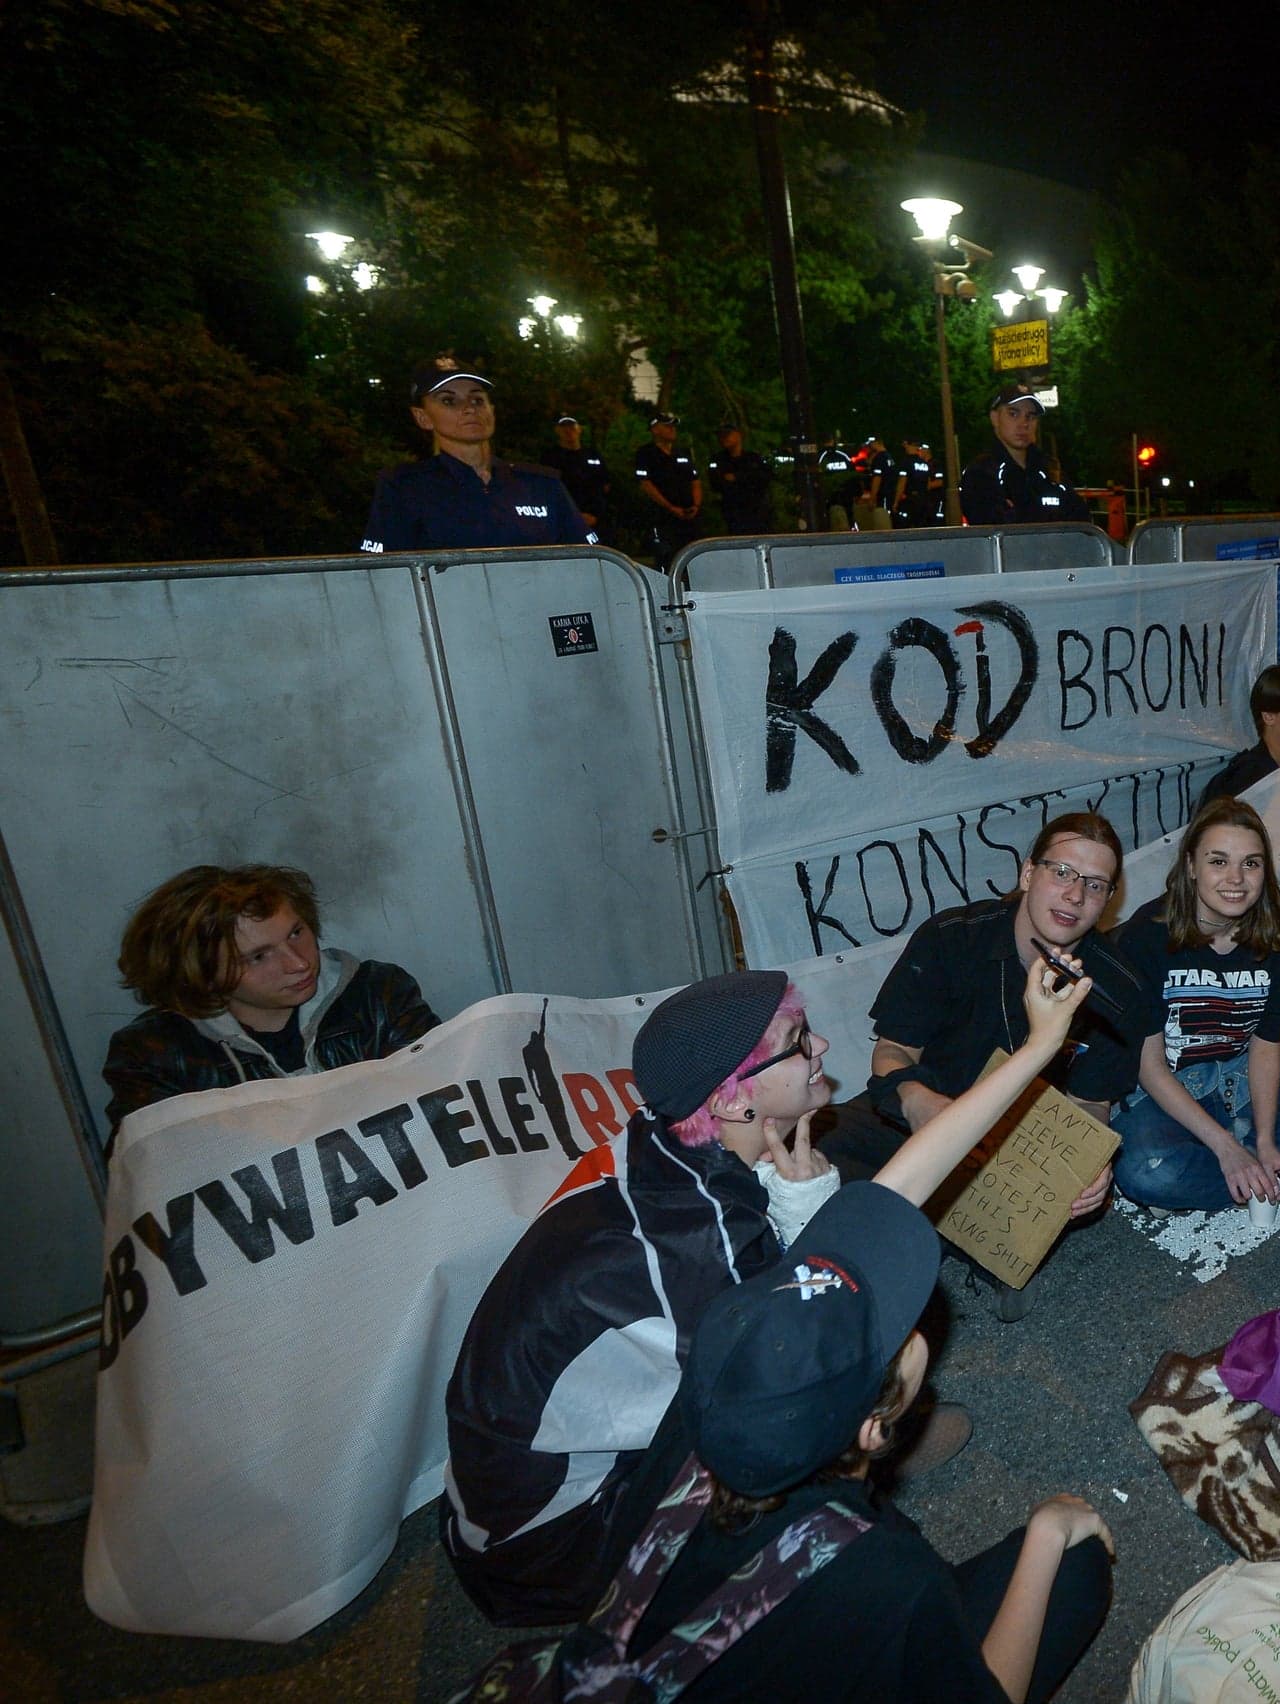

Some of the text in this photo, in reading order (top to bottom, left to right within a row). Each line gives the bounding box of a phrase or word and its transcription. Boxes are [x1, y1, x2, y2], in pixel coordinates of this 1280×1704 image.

[1057, 622, 1226, 731] BRONI
[1164, 969, 1271, 989] STAR WAR
[996, 1151, 1058, 1204] VE TO
[1012, 1133, 1052, 1176] TILL
[100, 1069, 647, 1371] OBYWATELE RP
[968, 1185, 1017, 1234] THIS
[976, 1171, 1049, 1223] OTEST
[947, 1207, 1034, 1277] KING SHIT
